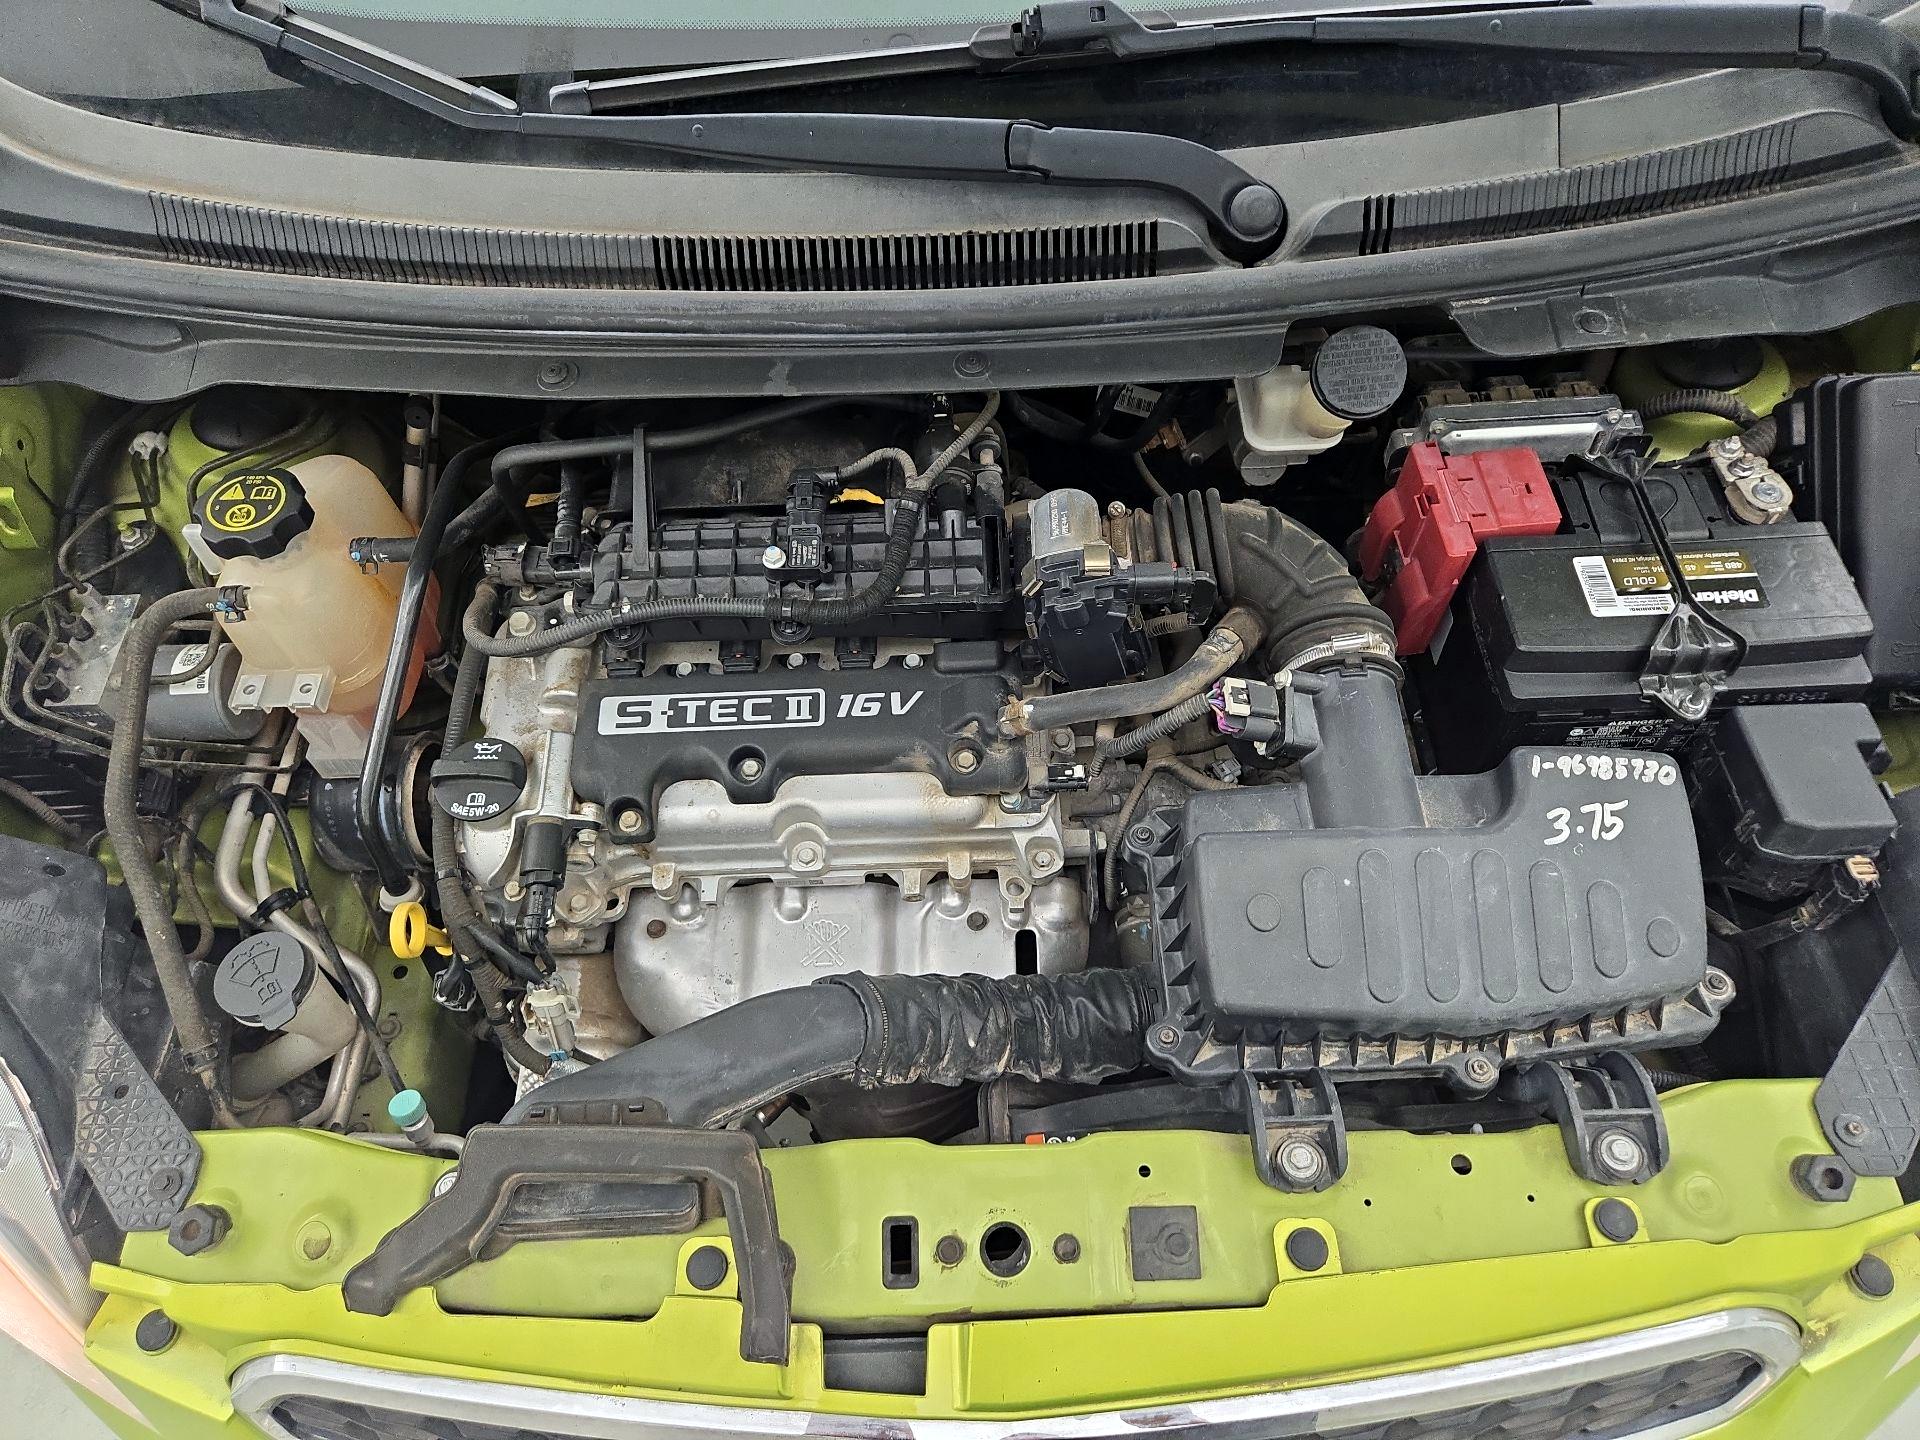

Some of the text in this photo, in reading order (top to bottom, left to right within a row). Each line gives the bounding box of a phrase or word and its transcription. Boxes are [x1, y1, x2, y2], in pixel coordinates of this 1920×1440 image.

[1623, 576, 1657, 586] GOLD
[1691, 588, 1760, 604] DieHar
[836, 690, 925, 718] 16V
[1543, 799, 1629, 846] 3.75
